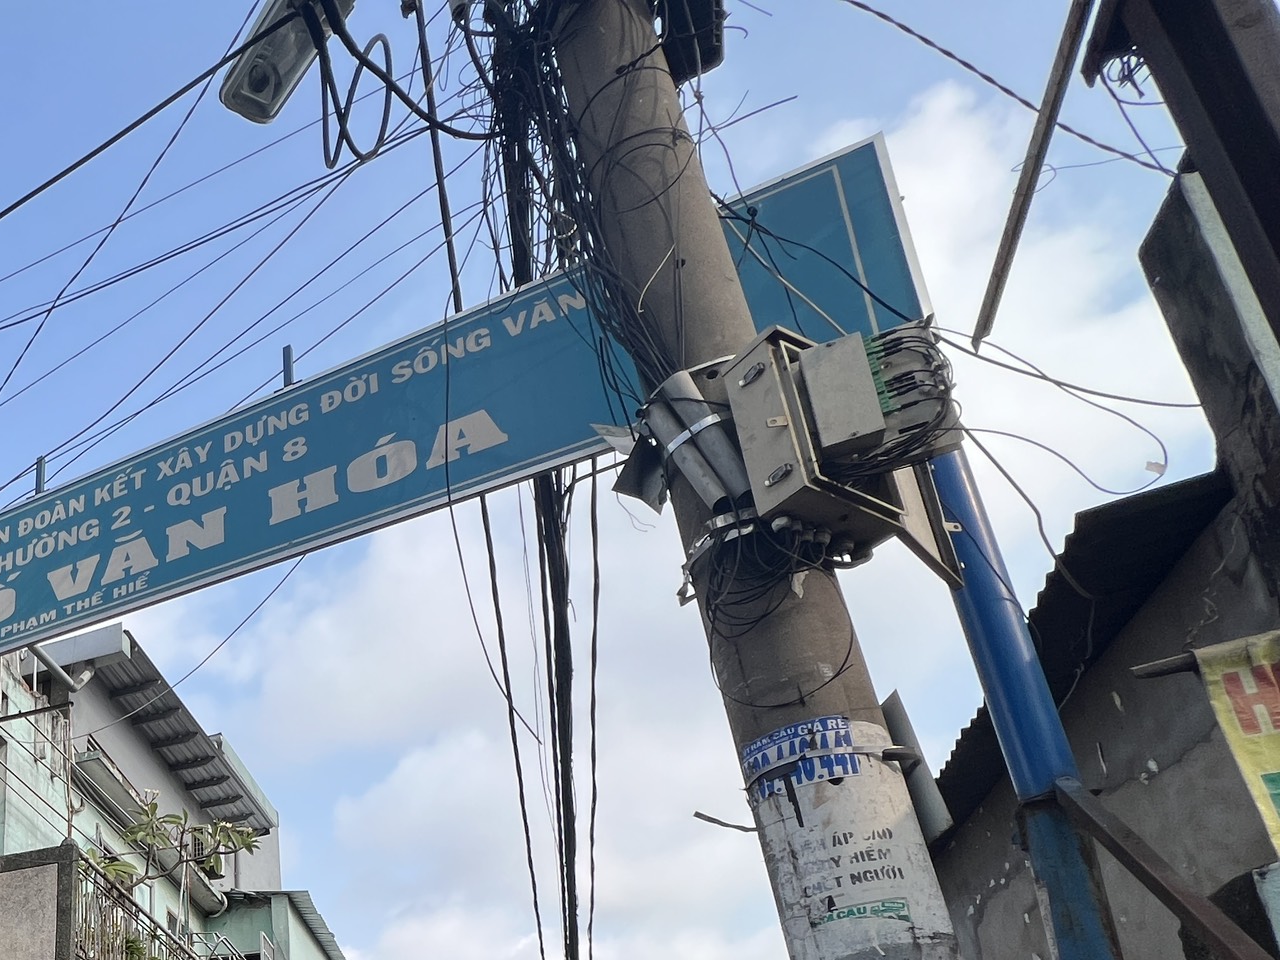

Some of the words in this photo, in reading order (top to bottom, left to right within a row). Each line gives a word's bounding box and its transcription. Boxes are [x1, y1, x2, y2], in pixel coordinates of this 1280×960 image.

[18, 494, 85, 536] ĐOÀN
[94, 467, 147, 506] KẾT
[156, 440, 213, 481] XÂY
[224, 402, 310, 453] DỰNG
[320, 372, 379, 414] ĐỜI
[391, 327, 492, 385] SỐNG
[502, 290, 587, 337] VĂN
[111, 506, 131, 530] 2
[166, 450, 268, 506] QUẬN
[282, 437, 308, 462] 8
[47, 506, 227, 601] VĂN
[268, 408, 509, 526] HÓA
[0, 609, 57, 638] PHẠM
[63, 588, 106, 616] THẾ
